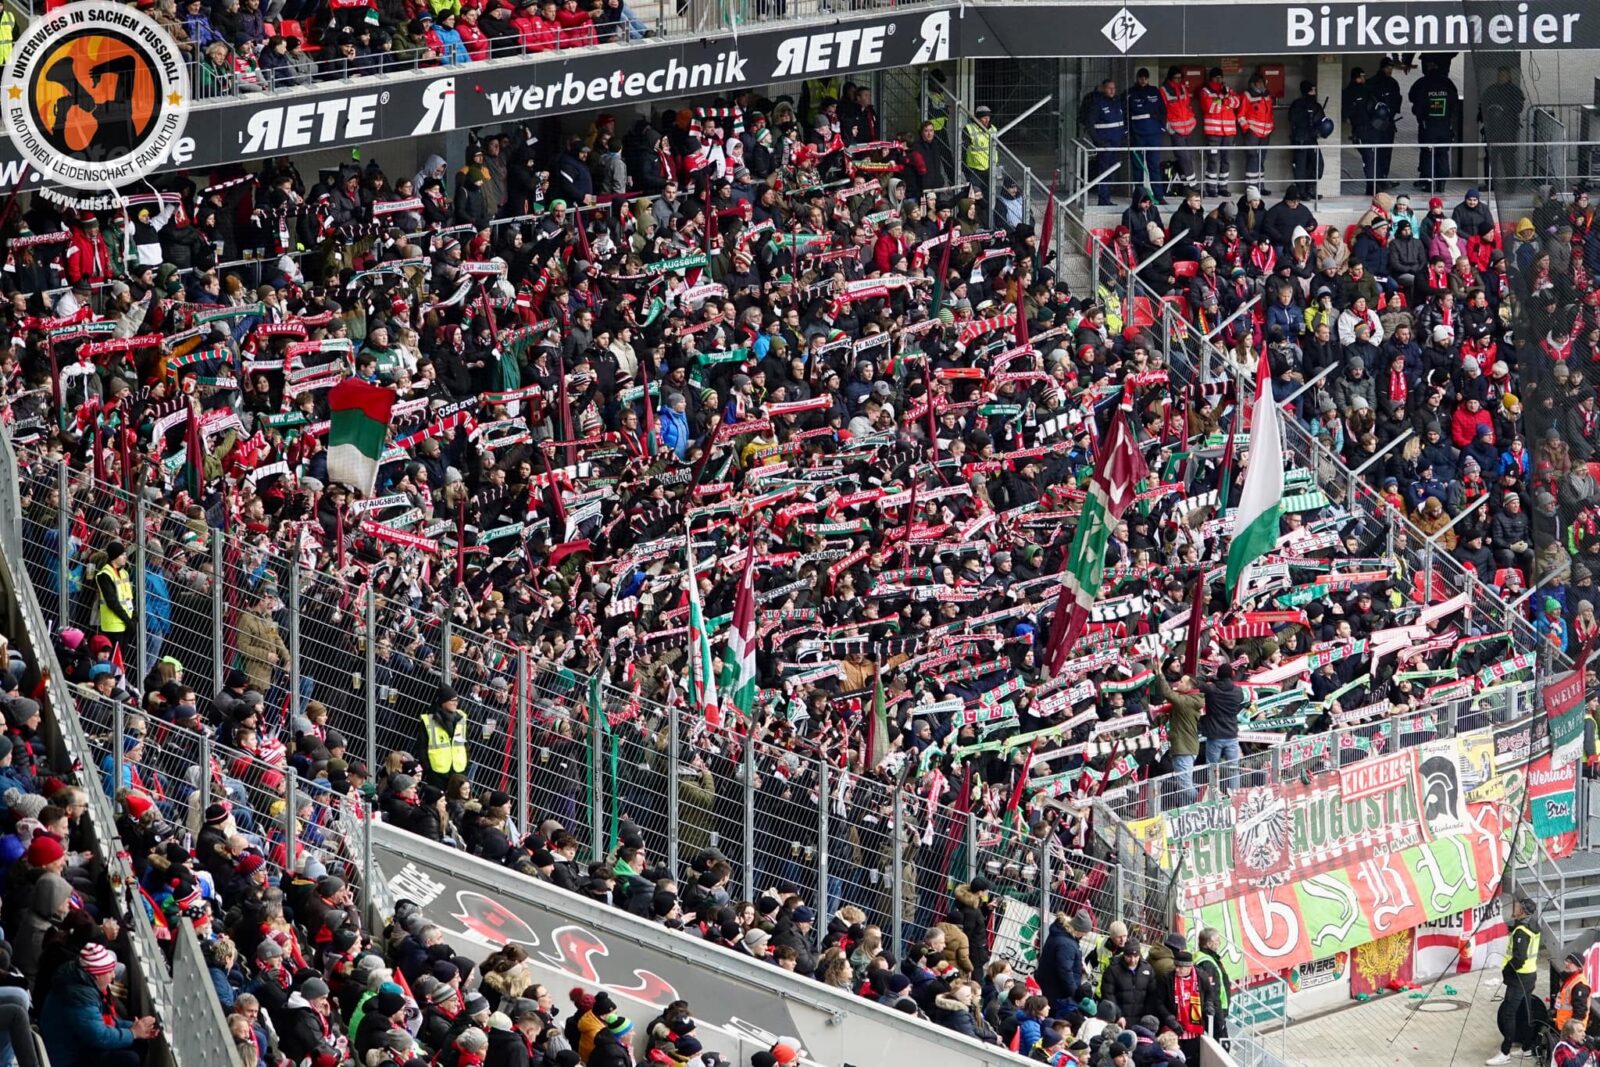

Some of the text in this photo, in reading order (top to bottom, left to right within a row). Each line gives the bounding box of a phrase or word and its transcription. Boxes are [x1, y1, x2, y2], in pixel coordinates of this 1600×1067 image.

[1286, 3, 1580, 46] Birkenmeier
[489, 51, 749, 116] werbetechnik
[649, 257, 706, 272] FC AUGSBURG
[526, 385, 541, 397] 190
[269, 414, 285, 424] WWK
[755, 462, 788, 477] AUGSBURG
[358, 495, 406, 510] FC AUGSBURG
[805, 519, 861, 533] FC AUGSBURG
[1169, 803, 1236, 841] LUSTENAU
[1299, 956, 1336, 977] RAVERS
